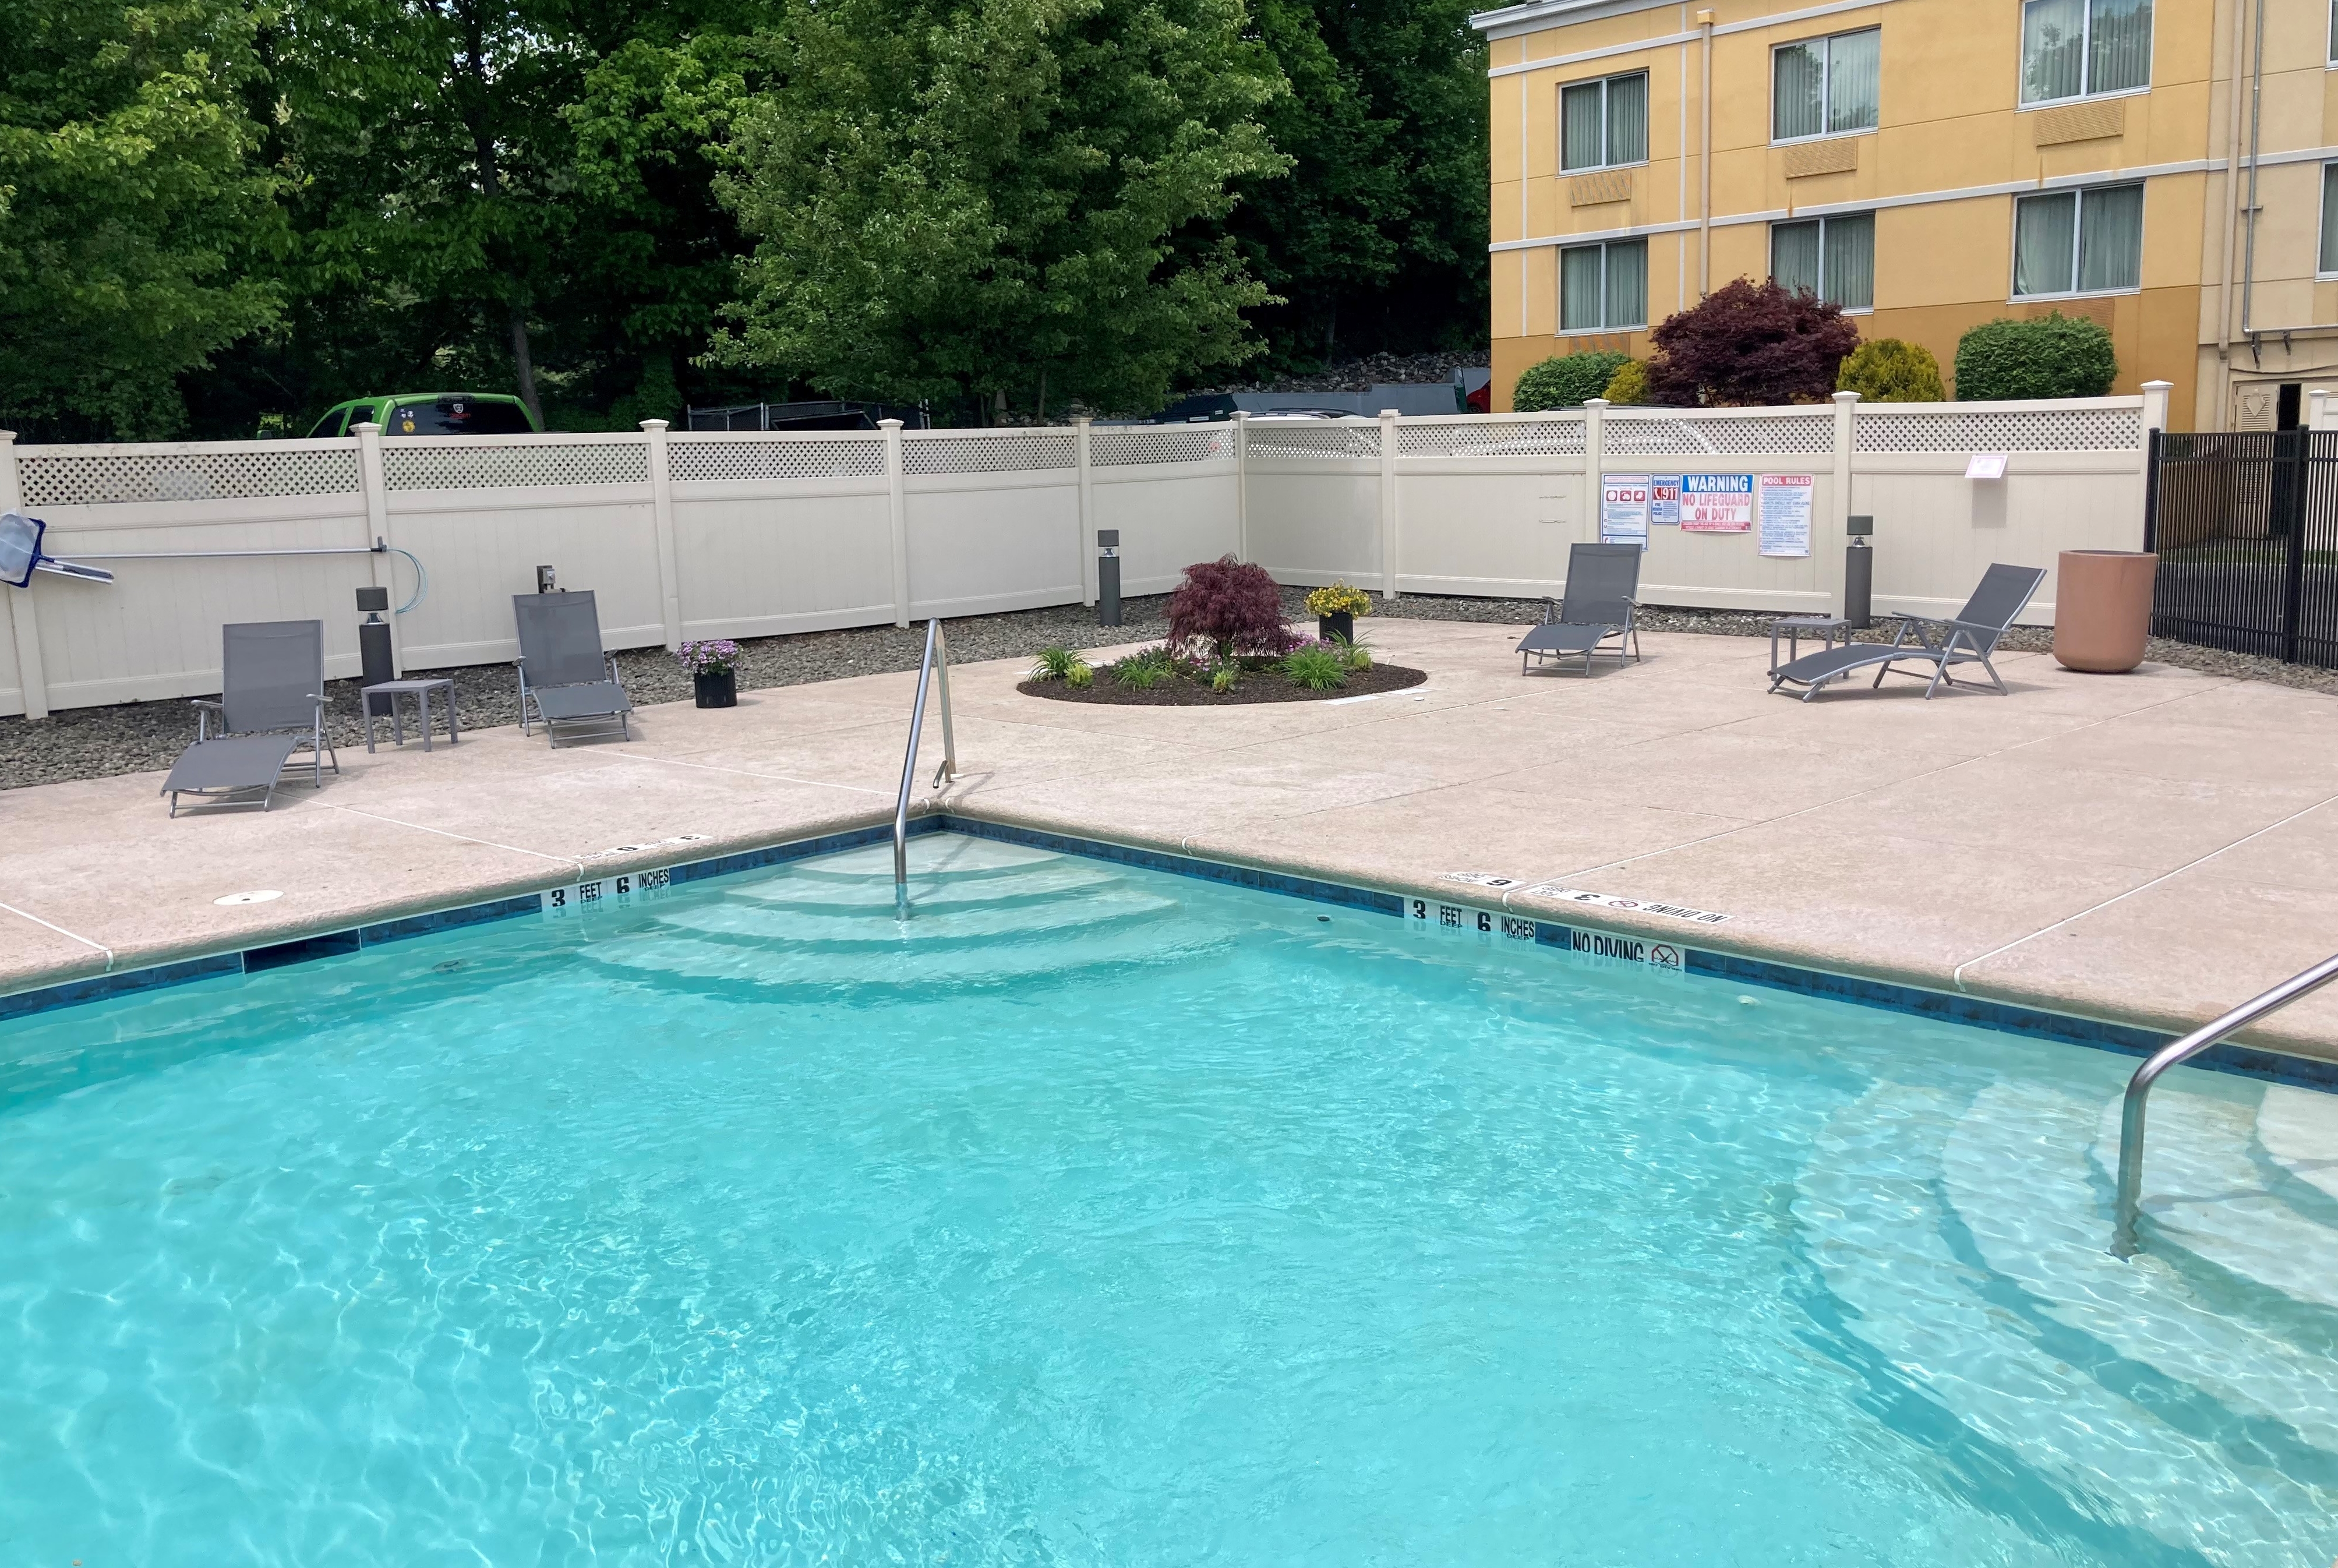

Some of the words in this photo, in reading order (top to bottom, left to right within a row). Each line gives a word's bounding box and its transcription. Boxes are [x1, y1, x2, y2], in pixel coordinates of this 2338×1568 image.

[1687, 475, 1749, 492] WARNING
[1763, 476, 1783, 485] POOL
[1786, 476, 1810, 485] RULES
[1662, 488, 1678, 500] 911
[1682, 493, 1696, 506] NO
[1699, 493, 1750, 507] LIFEGUARD
[1695, 507, 1708, 521] ON
[1711, 507, 1737, 521] DUTY
[552, 889, 566, 907] 3
[580, 881, 602, 900] FEET
[616, 876, 630, 894] 6
[638, 868, 669, 888] INCHES
[644, 883, 665, 891] DEEP
[580, 895, 603, 904] DEEP
[1413, 899, 1426, 919] 3
[1440, 905, 1462, 924] FEET
[1477, 911, 1491, 932] 6
[1501, 916, 1535, 938] INCHES
[1643, 904, 1701, 919] DIVING
[1697, 913, 1728, 923] NO
[1440, 920, 1463, 928] DEEP
[1572, 931, 1591, 953] NO
[1594, 935, 1644, 963] DIVING
